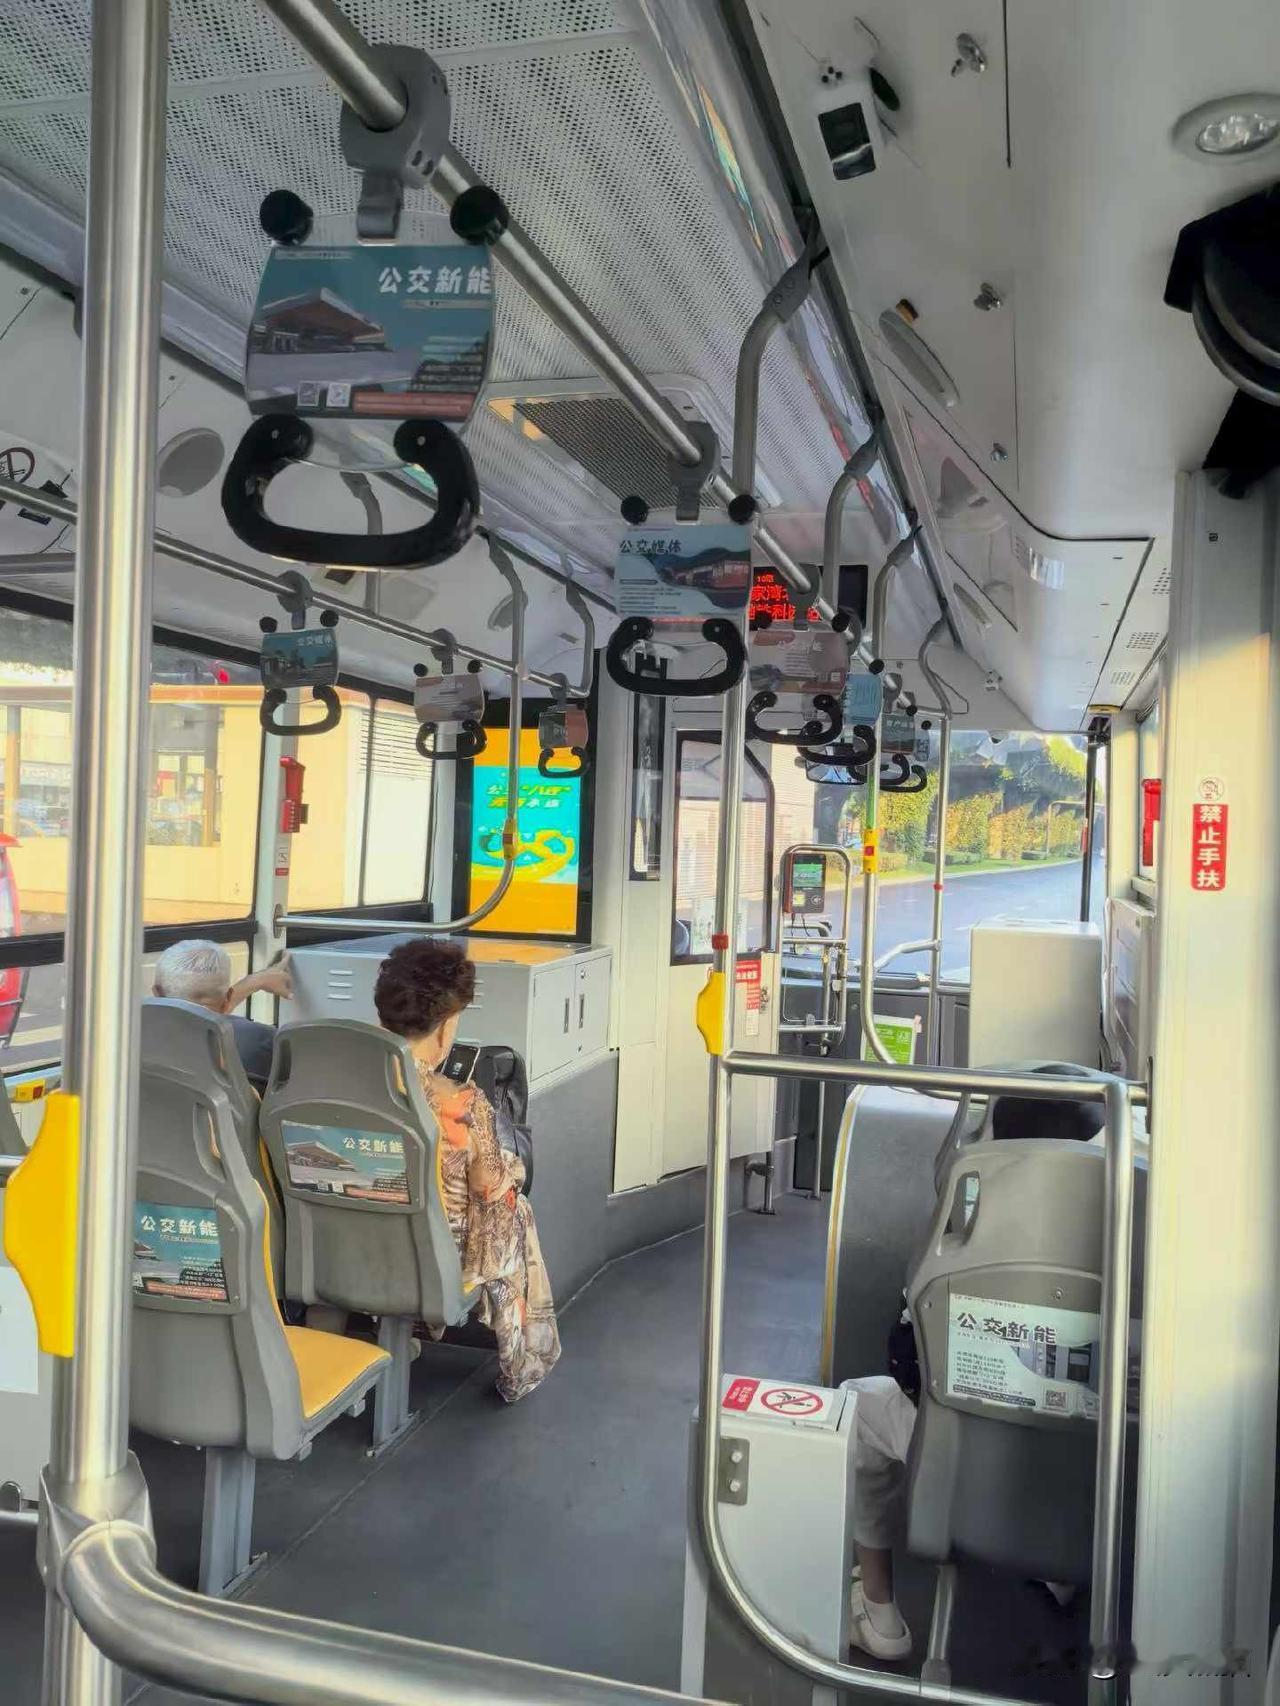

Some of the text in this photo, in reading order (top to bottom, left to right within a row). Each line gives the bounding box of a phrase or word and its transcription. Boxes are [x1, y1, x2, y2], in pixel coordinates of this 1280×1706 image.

[378, 265, 492, 295] 公交新能
[619, 539, 682, 554] 公交媒体
[1197, 805, 1222, 888] 禁止手扶
[343, 1136, 405, 1154] 公交新能
[141, 1215, 219, 1237] 公交新能
[956, 1311, 1056, 1345] 公交新能
